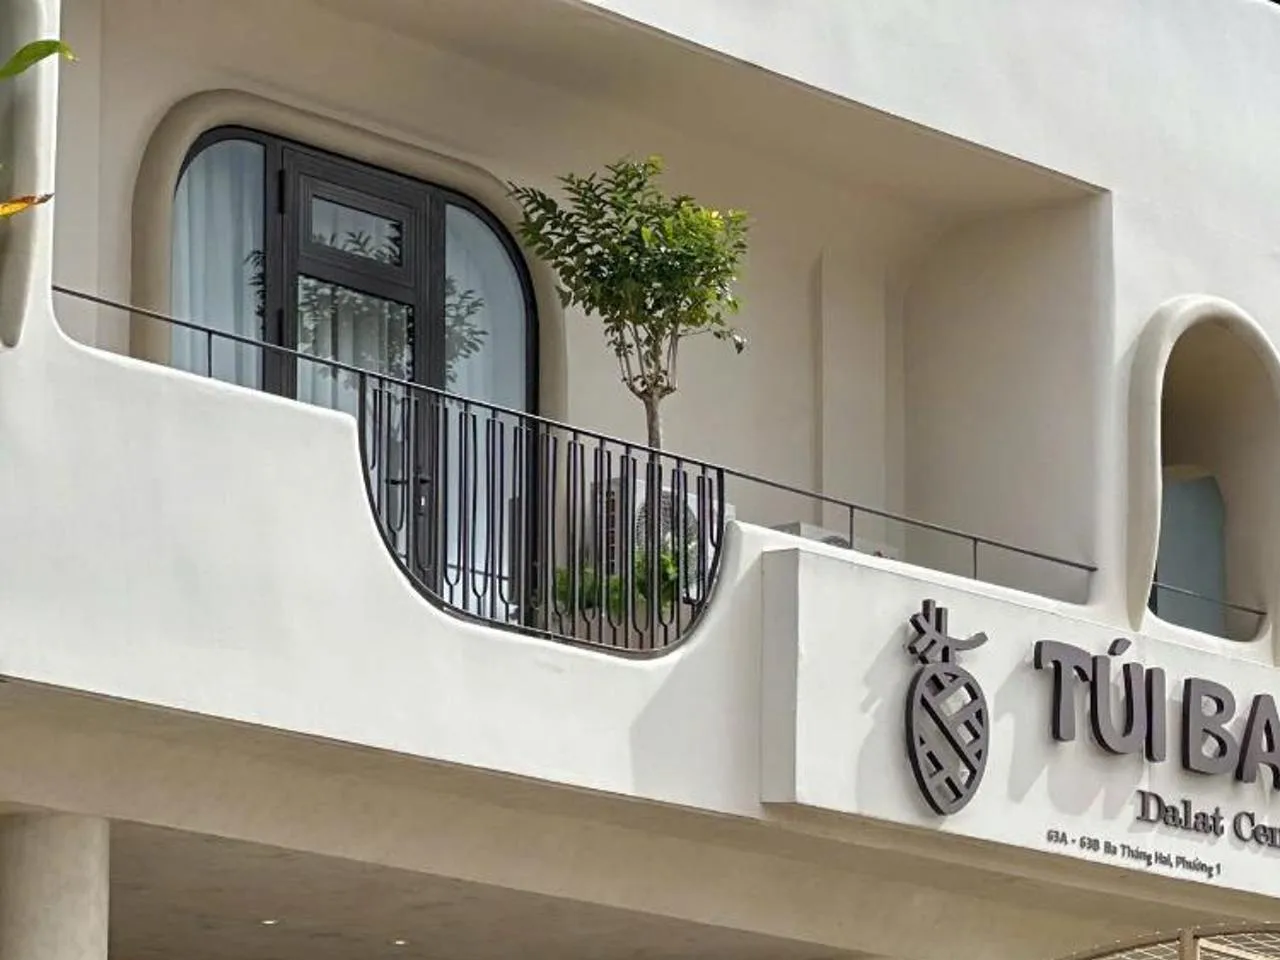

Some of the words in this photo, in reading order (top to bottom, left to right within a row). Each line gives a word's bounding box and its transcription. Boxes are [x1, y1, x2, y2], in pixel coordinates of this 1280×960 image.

[1034, 638, 1166, 762] TÚI
[1135, 791, 1225, 837] Dalat
[1047, 829, 1068, 846] 63A
[1103, 841, 1117, 855] Ba
[1216, 863, 1221, 875] 1
